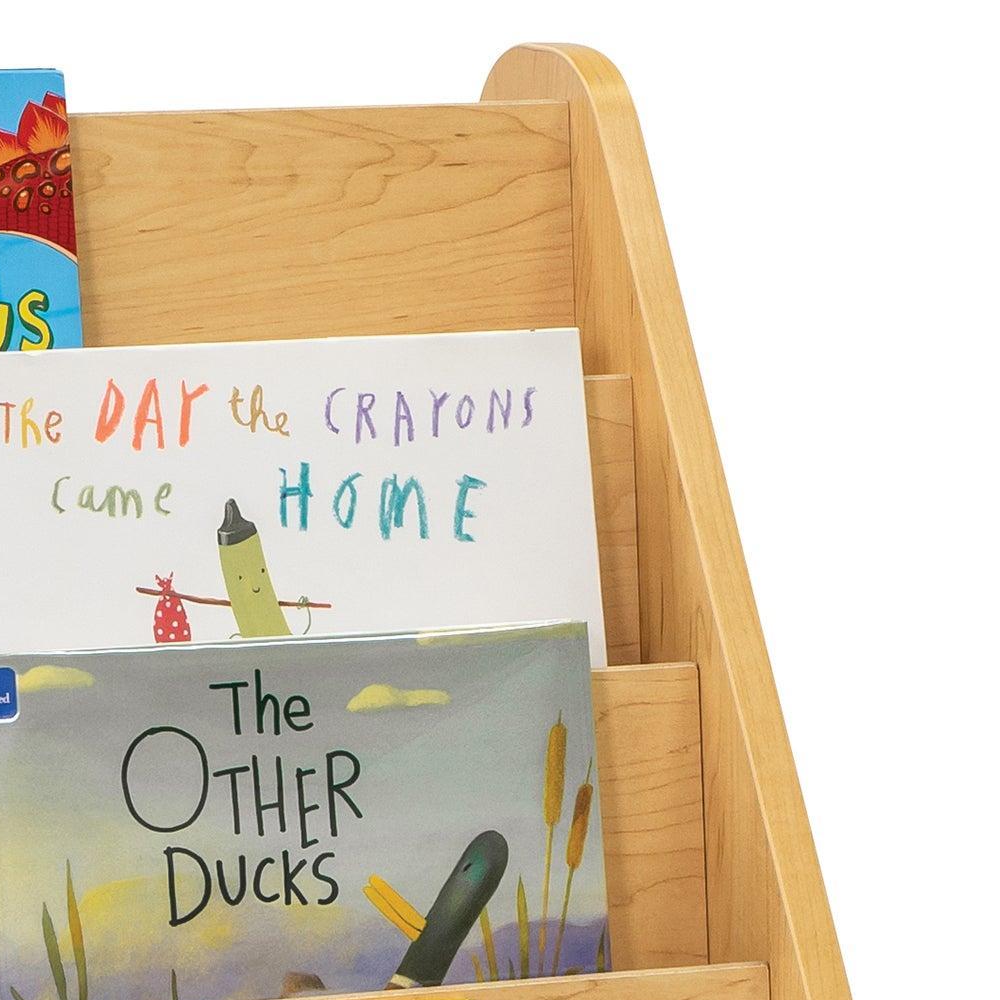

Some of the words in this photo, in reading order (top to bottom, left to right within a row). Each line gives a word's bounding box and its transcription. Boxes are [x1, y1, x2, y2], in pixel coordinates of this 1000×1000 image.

[0, 401, 63, 449] The
[95, 378, 209, 450] DAY
[228, 385, 290, 437] the
[325, 386, 537, 446] CRAYONS
[278, 462, 487, 542] HOME
[209, 669, 314, 735] The
[121, 726, 363, 849] OTHER
[164, 846, 339, 927] DUCKS
